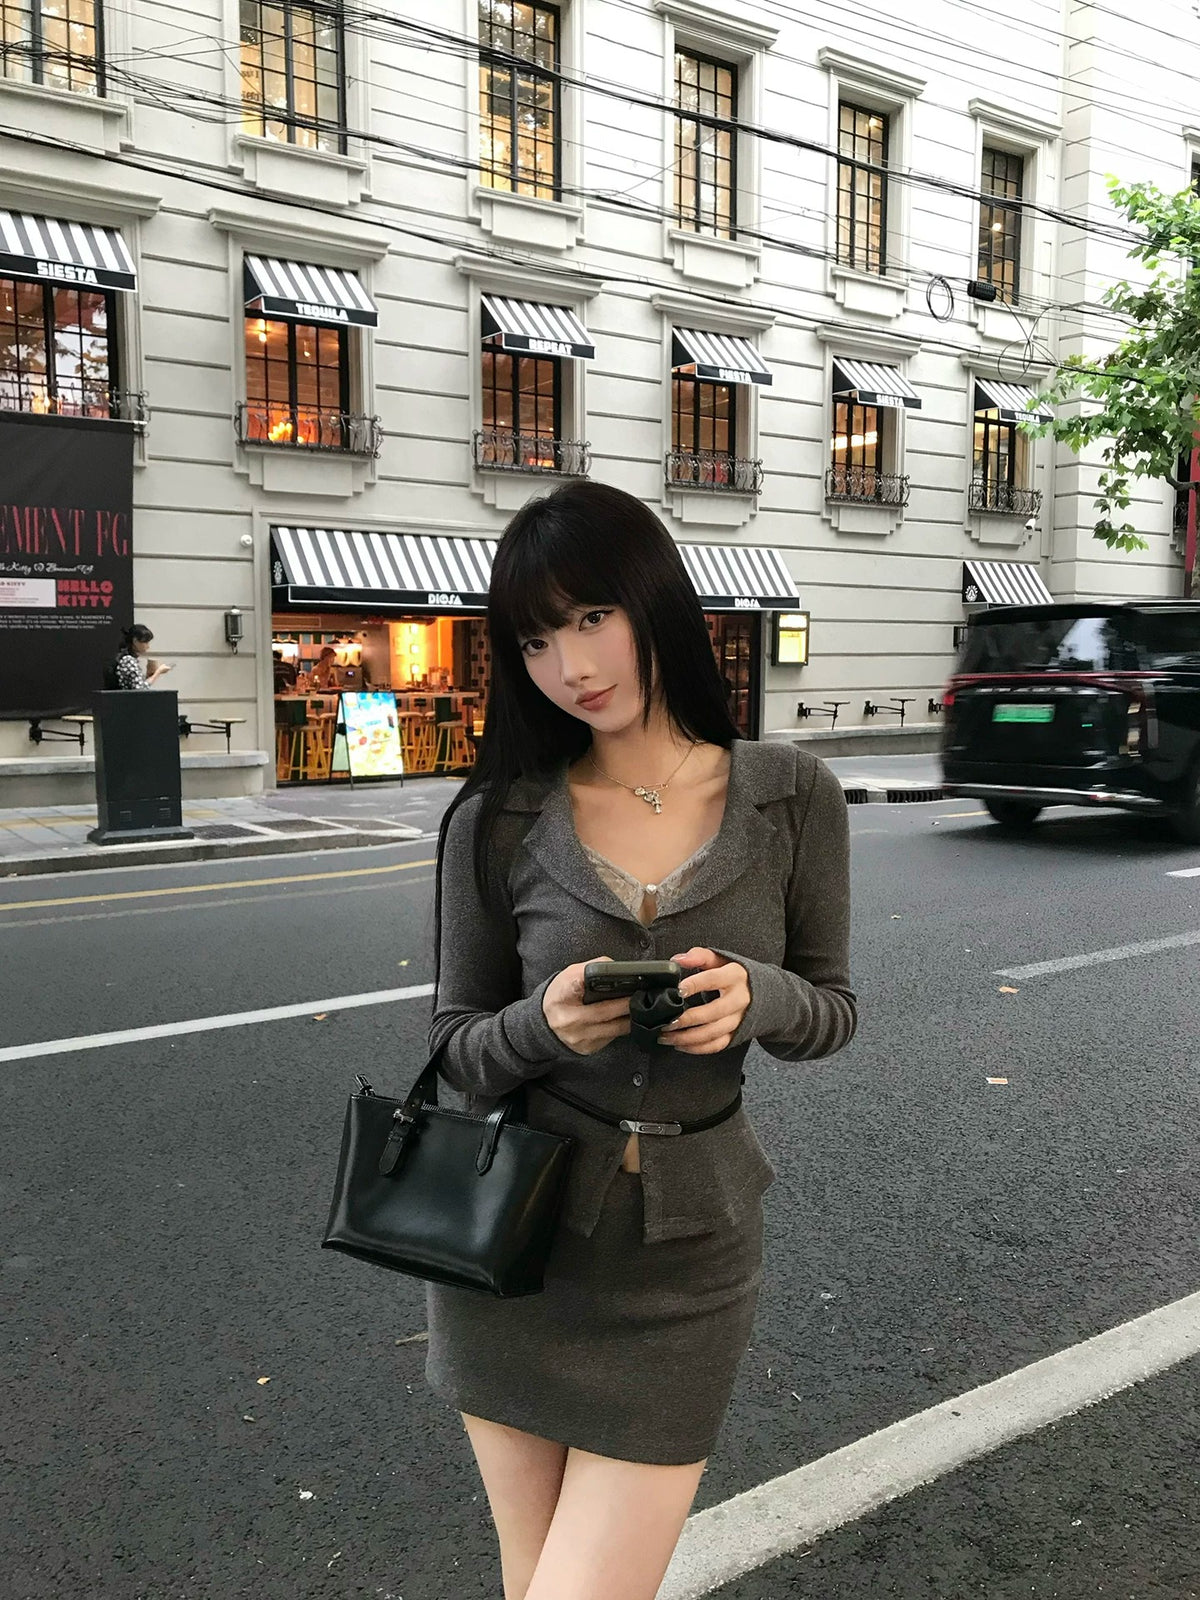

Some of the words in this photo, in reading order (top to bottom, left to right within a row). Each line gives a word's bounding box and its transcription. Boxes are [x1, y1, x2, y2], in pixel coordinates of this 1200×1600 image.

[36, 261, 98, 284] SIESTA
[295, 302, 349, 321] TEQUILA
[528, 338, 572, 356] REPEAT
[96, 510, 128, 557] FG
[57, 579, 114, 593] HELLO
[57, 594, 113, 608] KITTY
[428, 593, 463, 605] DIOSA
[734, 597, 761, 608] DIOSA
